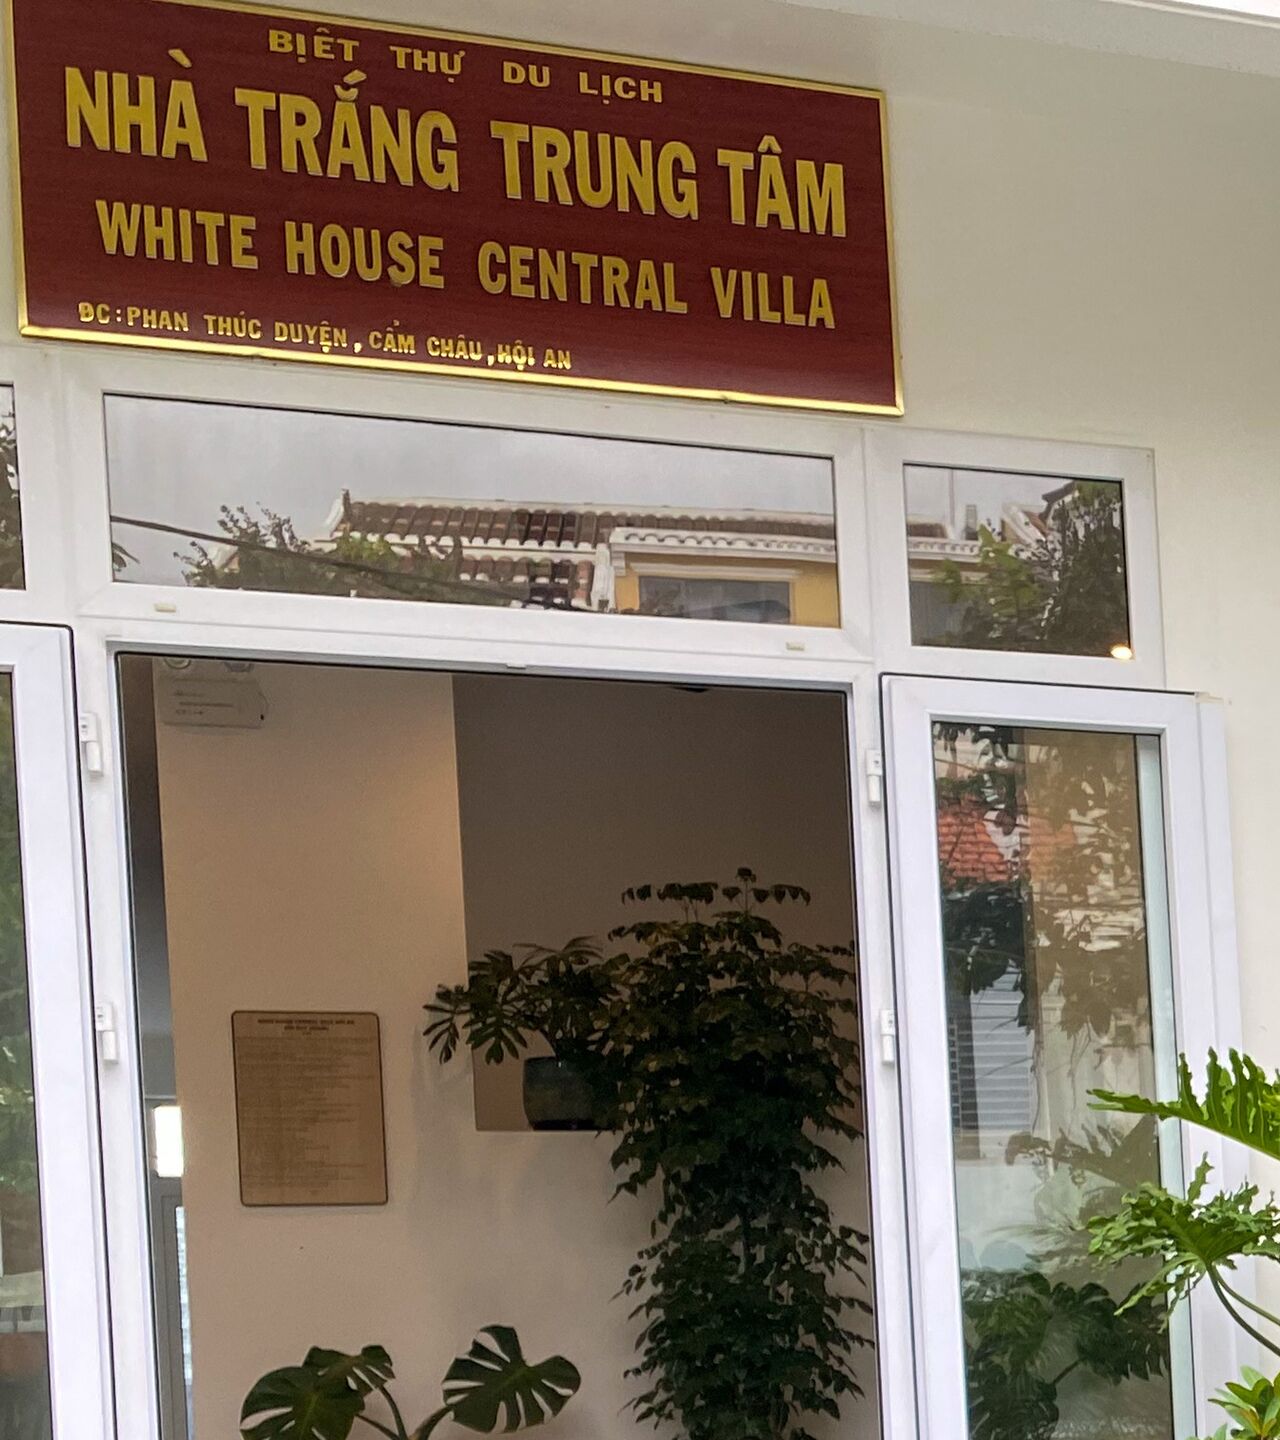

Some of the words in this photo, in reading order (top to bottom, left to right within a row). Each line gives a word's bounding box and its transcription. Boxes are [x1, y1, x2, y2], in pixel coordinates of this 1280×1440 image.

[389, 46, 466, 83] THỰ
[502, 61, 550, 88] DU
[579, 71, 662, 104] LỊCH
[64, 48, 209, 162] NHÀ
[234, 68, 460, 192] TRẮNG
[489, 120, 699, 221] TRUNG
[716, 135, 846, 238] TÂM
[95, 199, 259, 269] WHITE
[284, 220, 445, 289] HOUSE
[477, 241, 688, 314] CENTRAL
[710, 266, 835, 329] VILLA
[203, 310, 262, 339] THÚC
[543, 349, 572, 370] AN
